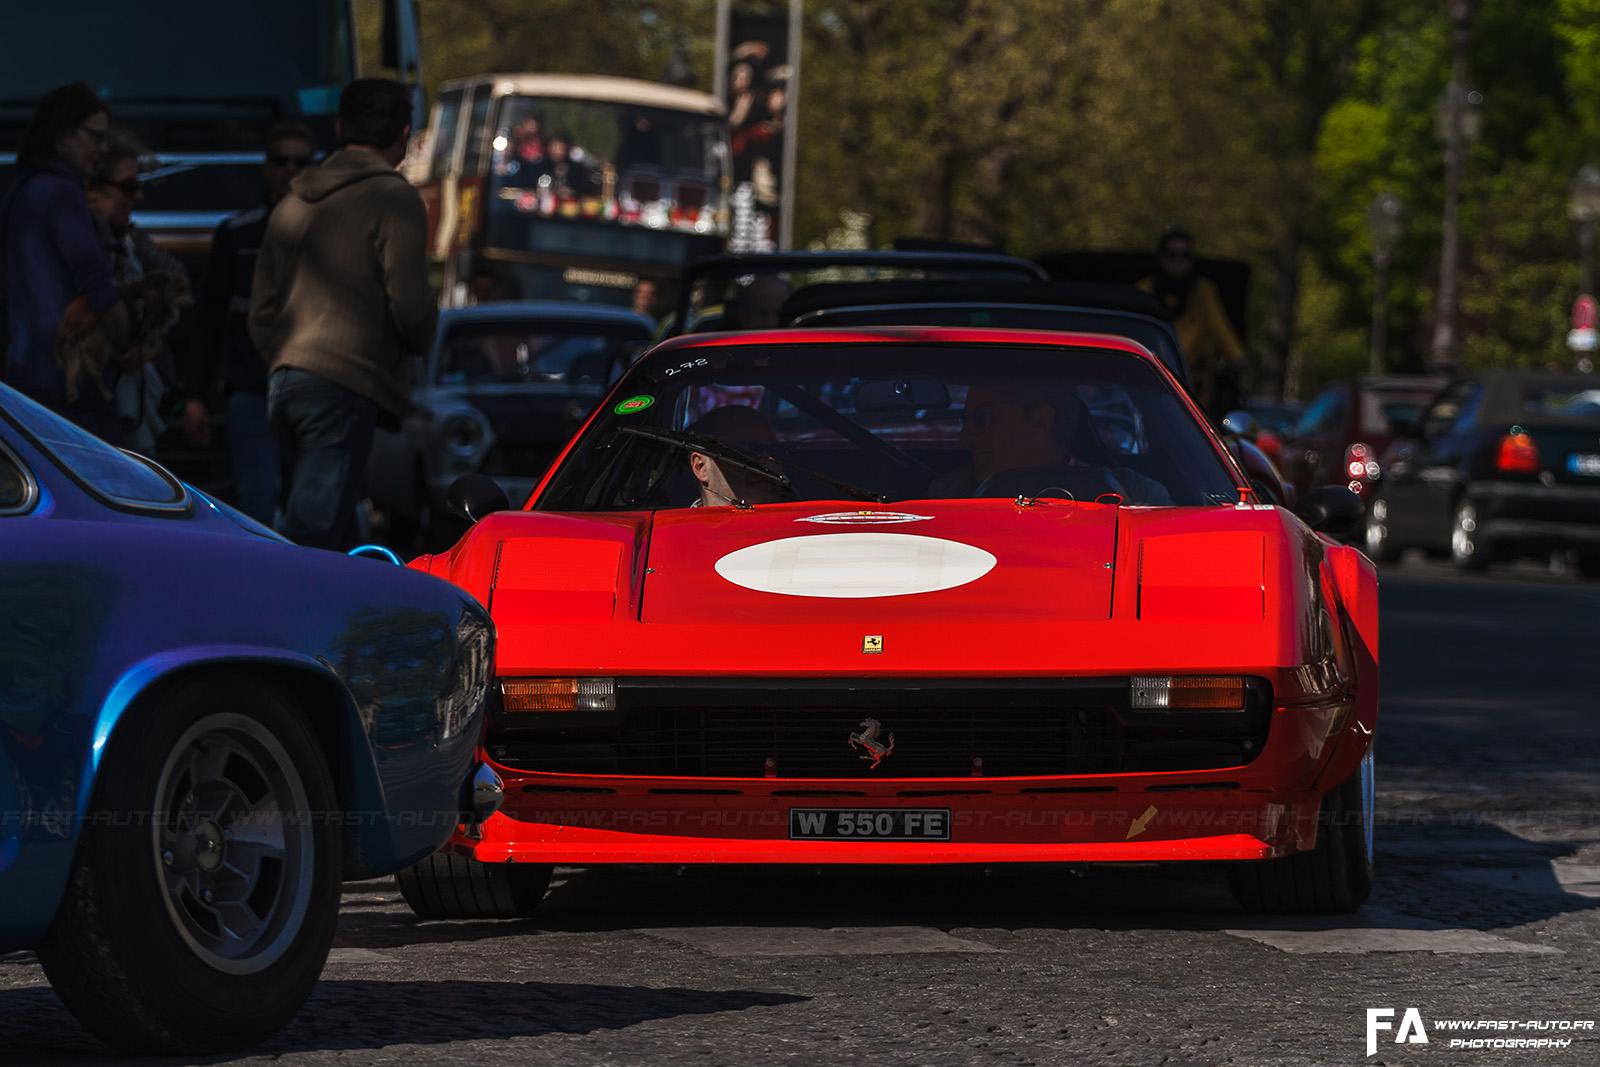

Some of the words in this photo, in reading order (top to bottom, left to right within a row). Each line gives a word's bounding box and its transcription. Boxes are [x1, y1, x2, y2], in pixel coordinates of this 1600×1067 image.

[798, 812, 827, 835] W
[837, 812, 893, 836] 550
[904, 812, 943, 836] FE
